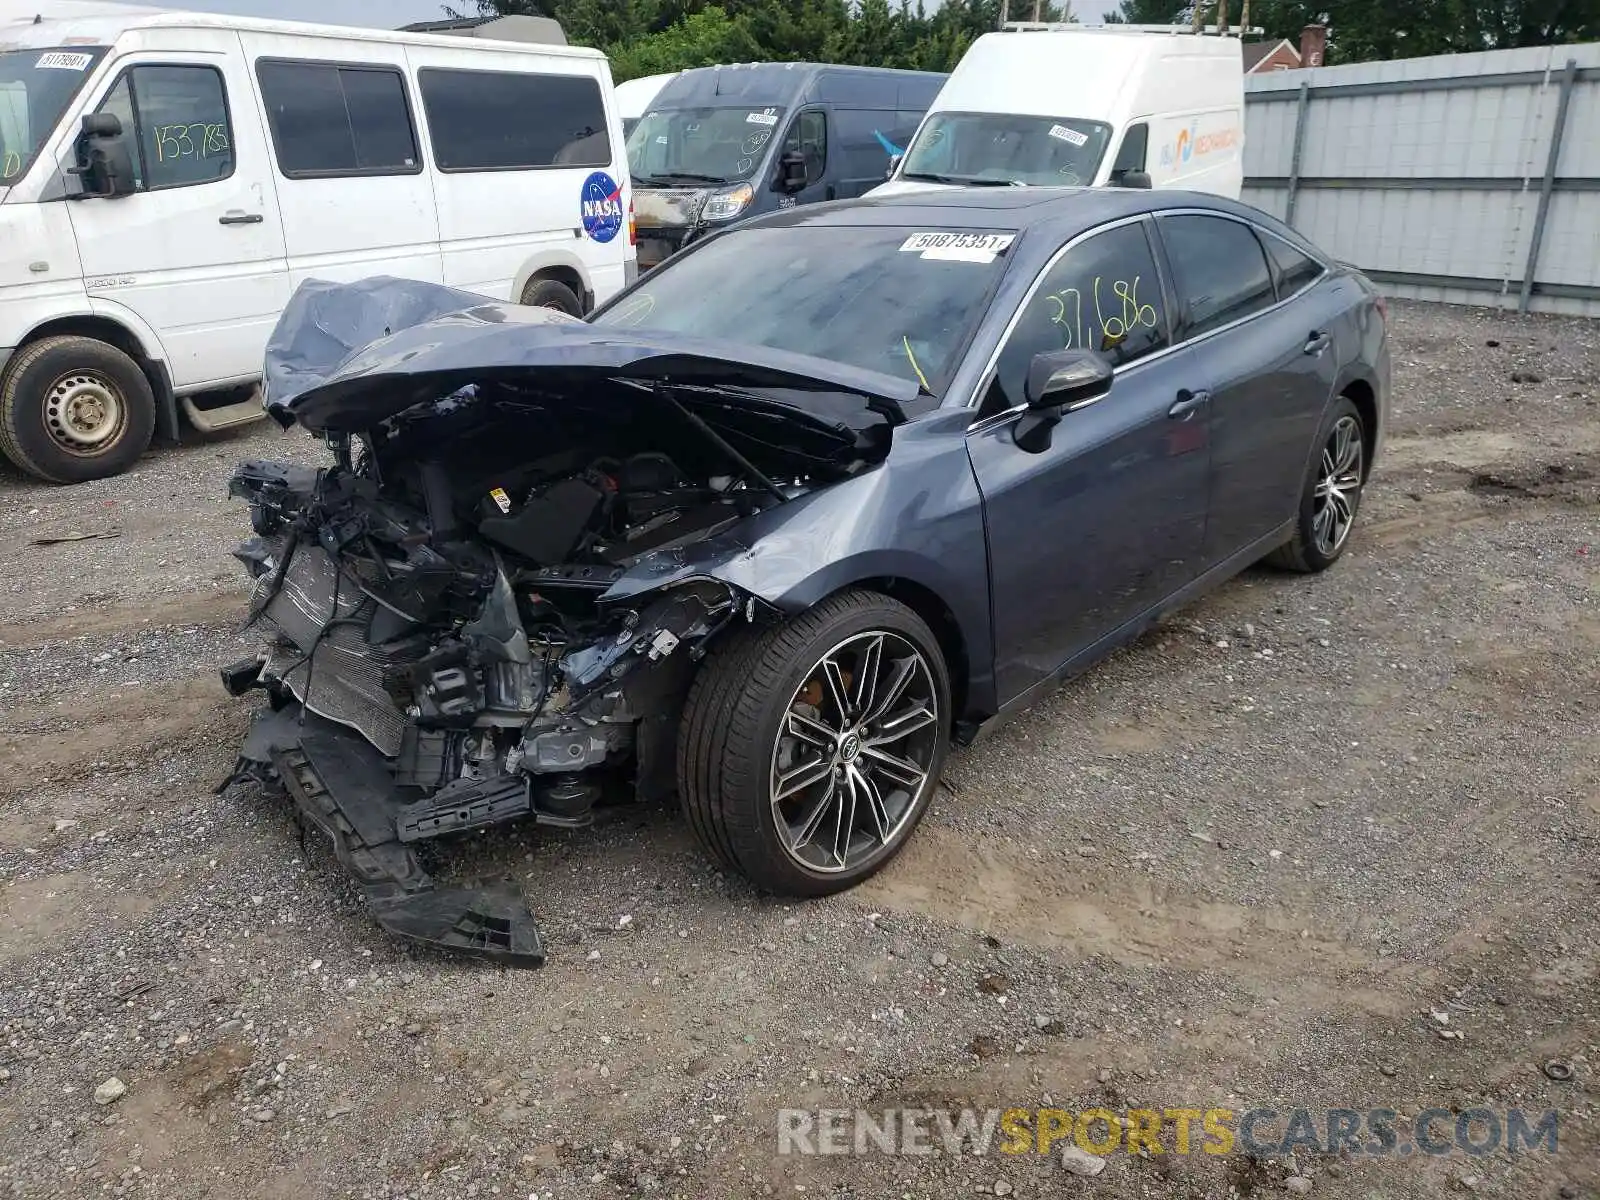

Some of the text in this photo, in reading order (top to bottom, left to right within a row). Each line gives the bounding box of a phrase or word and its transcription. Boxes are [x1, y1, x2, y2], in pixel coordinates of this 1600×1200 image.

[154, 123, 229, 162] 153,785
[583, 200, 622, 217] NASA
[915, 233, 1000, 249] 50875351
[1045, 275, 1157, 351] 37,686
